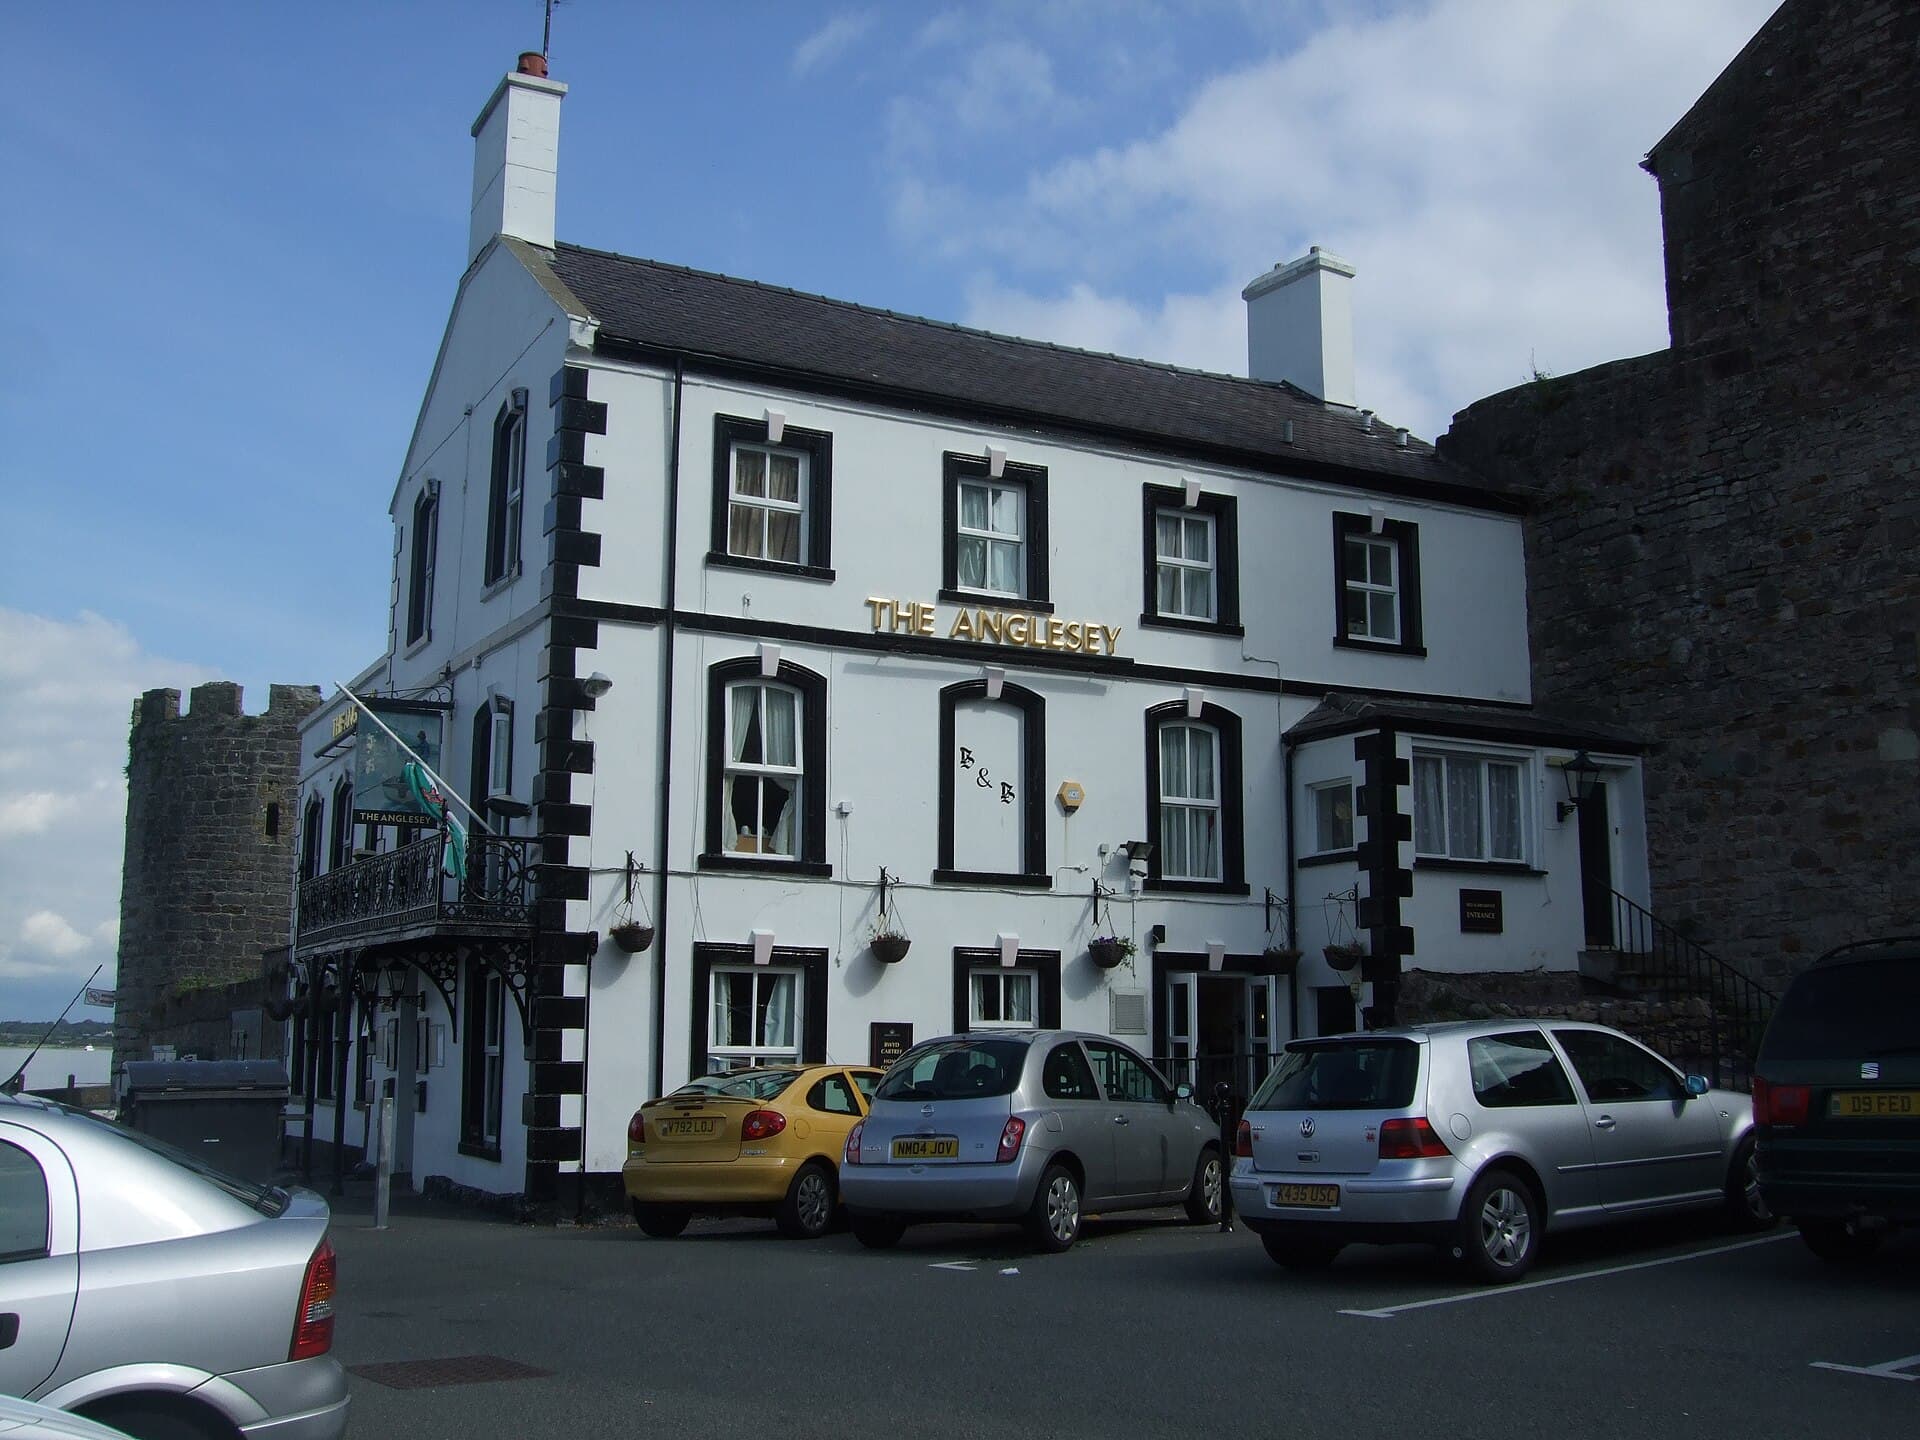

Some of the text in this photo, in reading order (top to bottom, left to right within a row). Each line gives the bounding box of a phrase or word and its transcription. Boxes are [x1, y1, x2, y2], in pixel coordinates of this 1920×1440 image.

[865, 596, 1122, 654] THE ANGLESEY
[959, 746, 1016, 805] B & B
[360, 812, 431, 824] THE ANGLESEY
[1466, 911, 1496, 919] ENTRANCE
[897, 1140, 927, 1155] NM04
[929, 1140, 953, 1155] JOV
